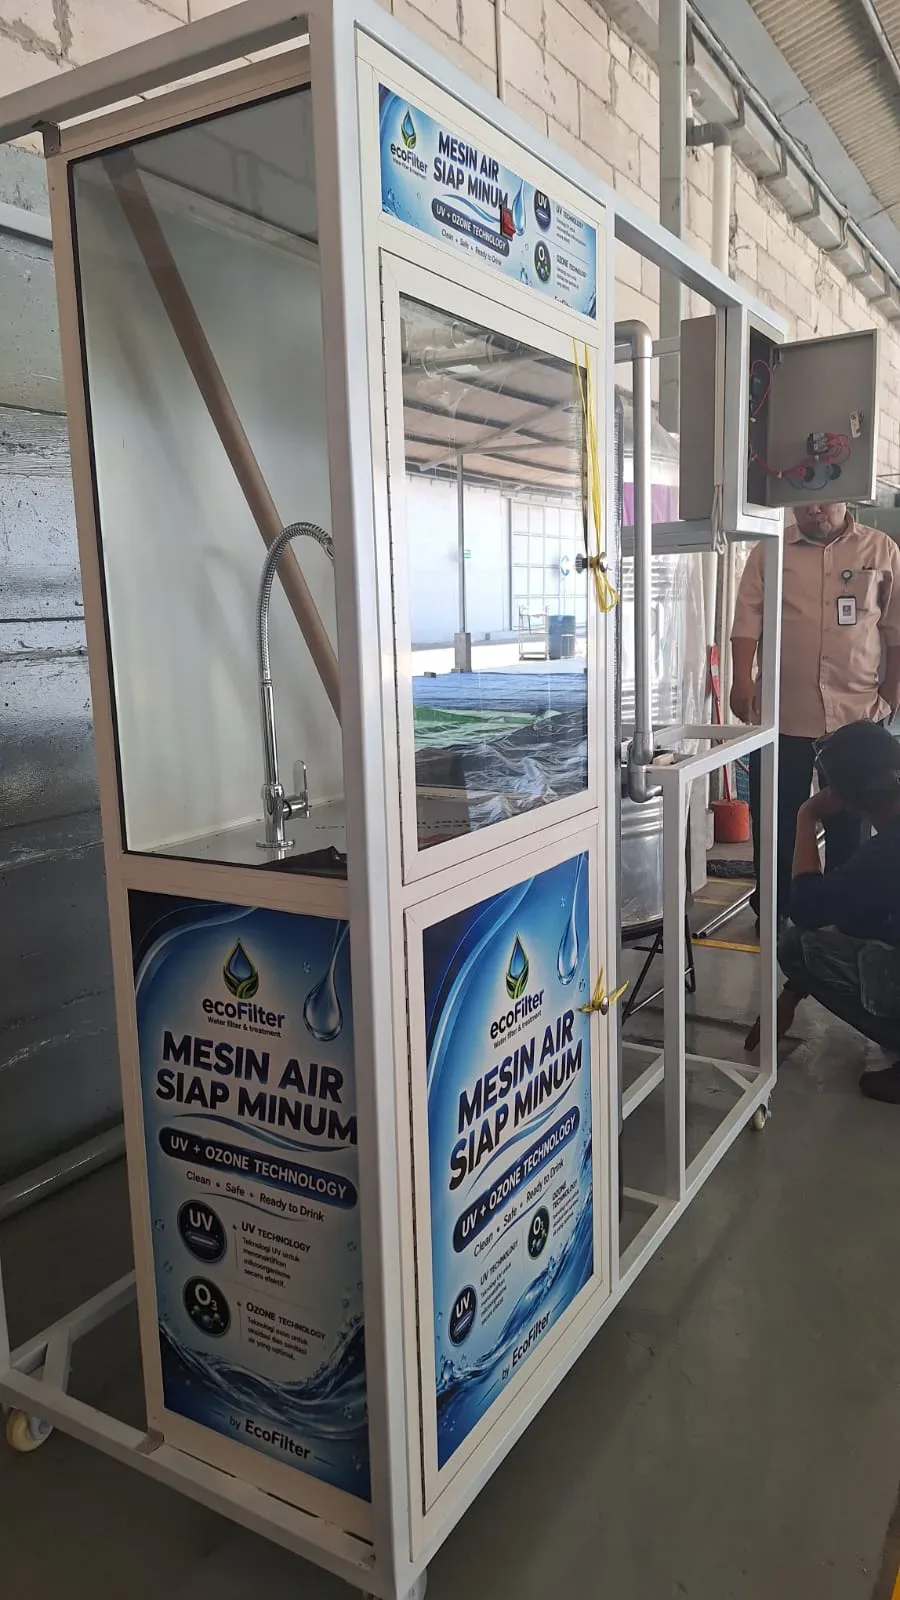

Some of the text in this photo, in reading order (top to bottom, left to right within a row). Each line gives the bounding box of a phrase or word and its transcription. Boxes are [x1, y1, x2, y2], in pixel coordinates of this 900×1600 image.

[390, 143, 428, 174] ecoFilter
[438, 131, 478, 172] MESIN
[480, 154, 499, 183] AIR
[433, 156, 465, 191] SIAP
[467, 174, 508, 210] MINUM
[538, 192, 548, 209] UV
[436, 204, 446, 217] UV
[451, 213, 472, 232] OZONE
[472, 224, 506, 251] TECHNOLOGY
[202, 998, 286, 1029] ecoFilter
[207, 1016, 226, 1026] Water
[226, 1019, 242, 1029] filter
[243, 1023, 248, 1031] &
[490, 989, 544, 1039] ecoFilter
[162, 1030, 344, 1104] MESIN AIR
[458, 1010, 575, 1135] MESIN AIR
[155, 1068, 358, 1145] SIAP MINUM
[449, 1038, 583, 1191] SIAP MINUM
[170, 1135, 347, 1200] UV + OZONE TECHNOLOGY
[461, 1209, 478, 1238] UV
[480, 1205, 487, 1217] +
[489, 1167, 521, 1210] OZONE
[524, 1114, 577, 1177] TECHNOLOGY
[186, 1170, 325, 1222] Clean Safe Ready to Drink
[474, 1158, 564, 1257] Clean Safe Ready to Drink
[552, 1178, 578, 1210] TECHNOLOGY
[188, 1208, 213, 1232] UV
[241, 1221, 311, 1254] UV TECHNOLOGY
[271, 1247, 282, 1256] UV
[480, 1269, 489, 1286] UV
[489, 1239, 518, 1275] TECHNOLOGY
[194, 1283, 218, 1311] O3
[456, 1292, 471, 1318] UV
[246, 1302, 326, 1340] OZONE TECHNOLOGY
[502, 1311, 551, 1380] by EcoFilter
[229, 1415, 312, 1459] by EcoFilter
